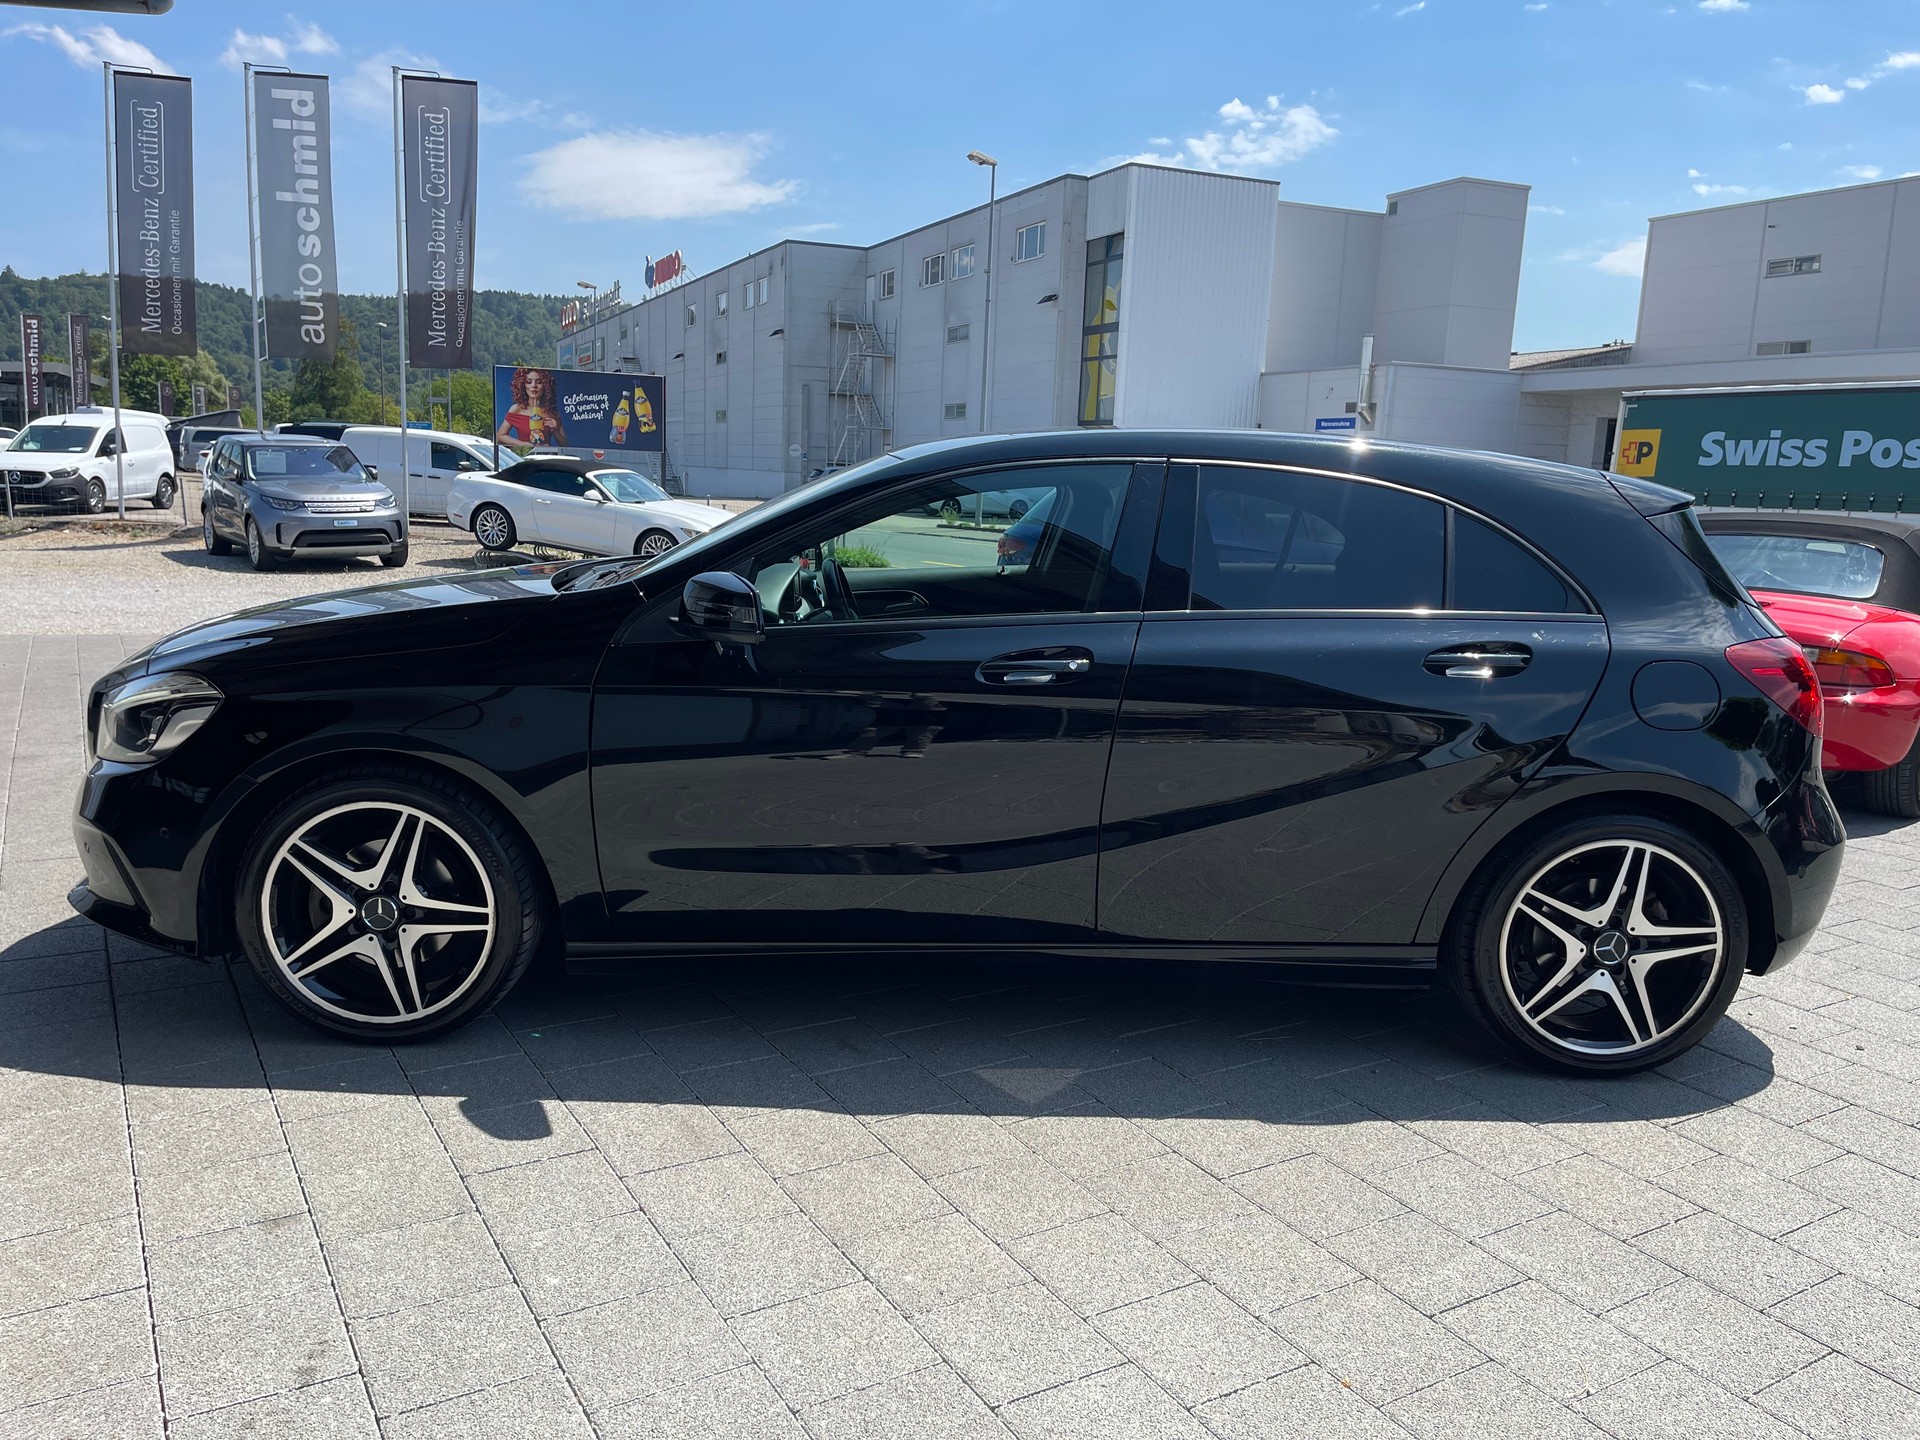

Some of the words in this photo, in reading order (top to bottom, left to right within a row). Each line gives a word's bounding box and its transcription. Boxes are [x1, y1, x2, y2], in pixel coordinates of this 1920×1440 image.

[137, 107, 159, 188] Certified
[425, 113, 446, 198] Certified
[169, 210, 180, 254] Garantie
[454, 220, 464, 265] Garantie
[140, 198, 161, 334] Mercedes-Benz
[170, 257, 180, 273] mit
[428, 208, 447, 348] Mercedes-Benz
[455, 268, 464, 284] mit
[171, 276, 182, 335] Occasionen
[455, 288, 466, 348] Occasionen
[563, 393, 608, 405] Celebrating
[564, 405, 575, 413] 90
[577, 403, 599, 413] years
[600, 401, 610, 410] of
[572, 410, 604, 420] shaking!
[1698, 430, 1828, 467] Swiss
[1838, 430, 1920, 469] Pos
